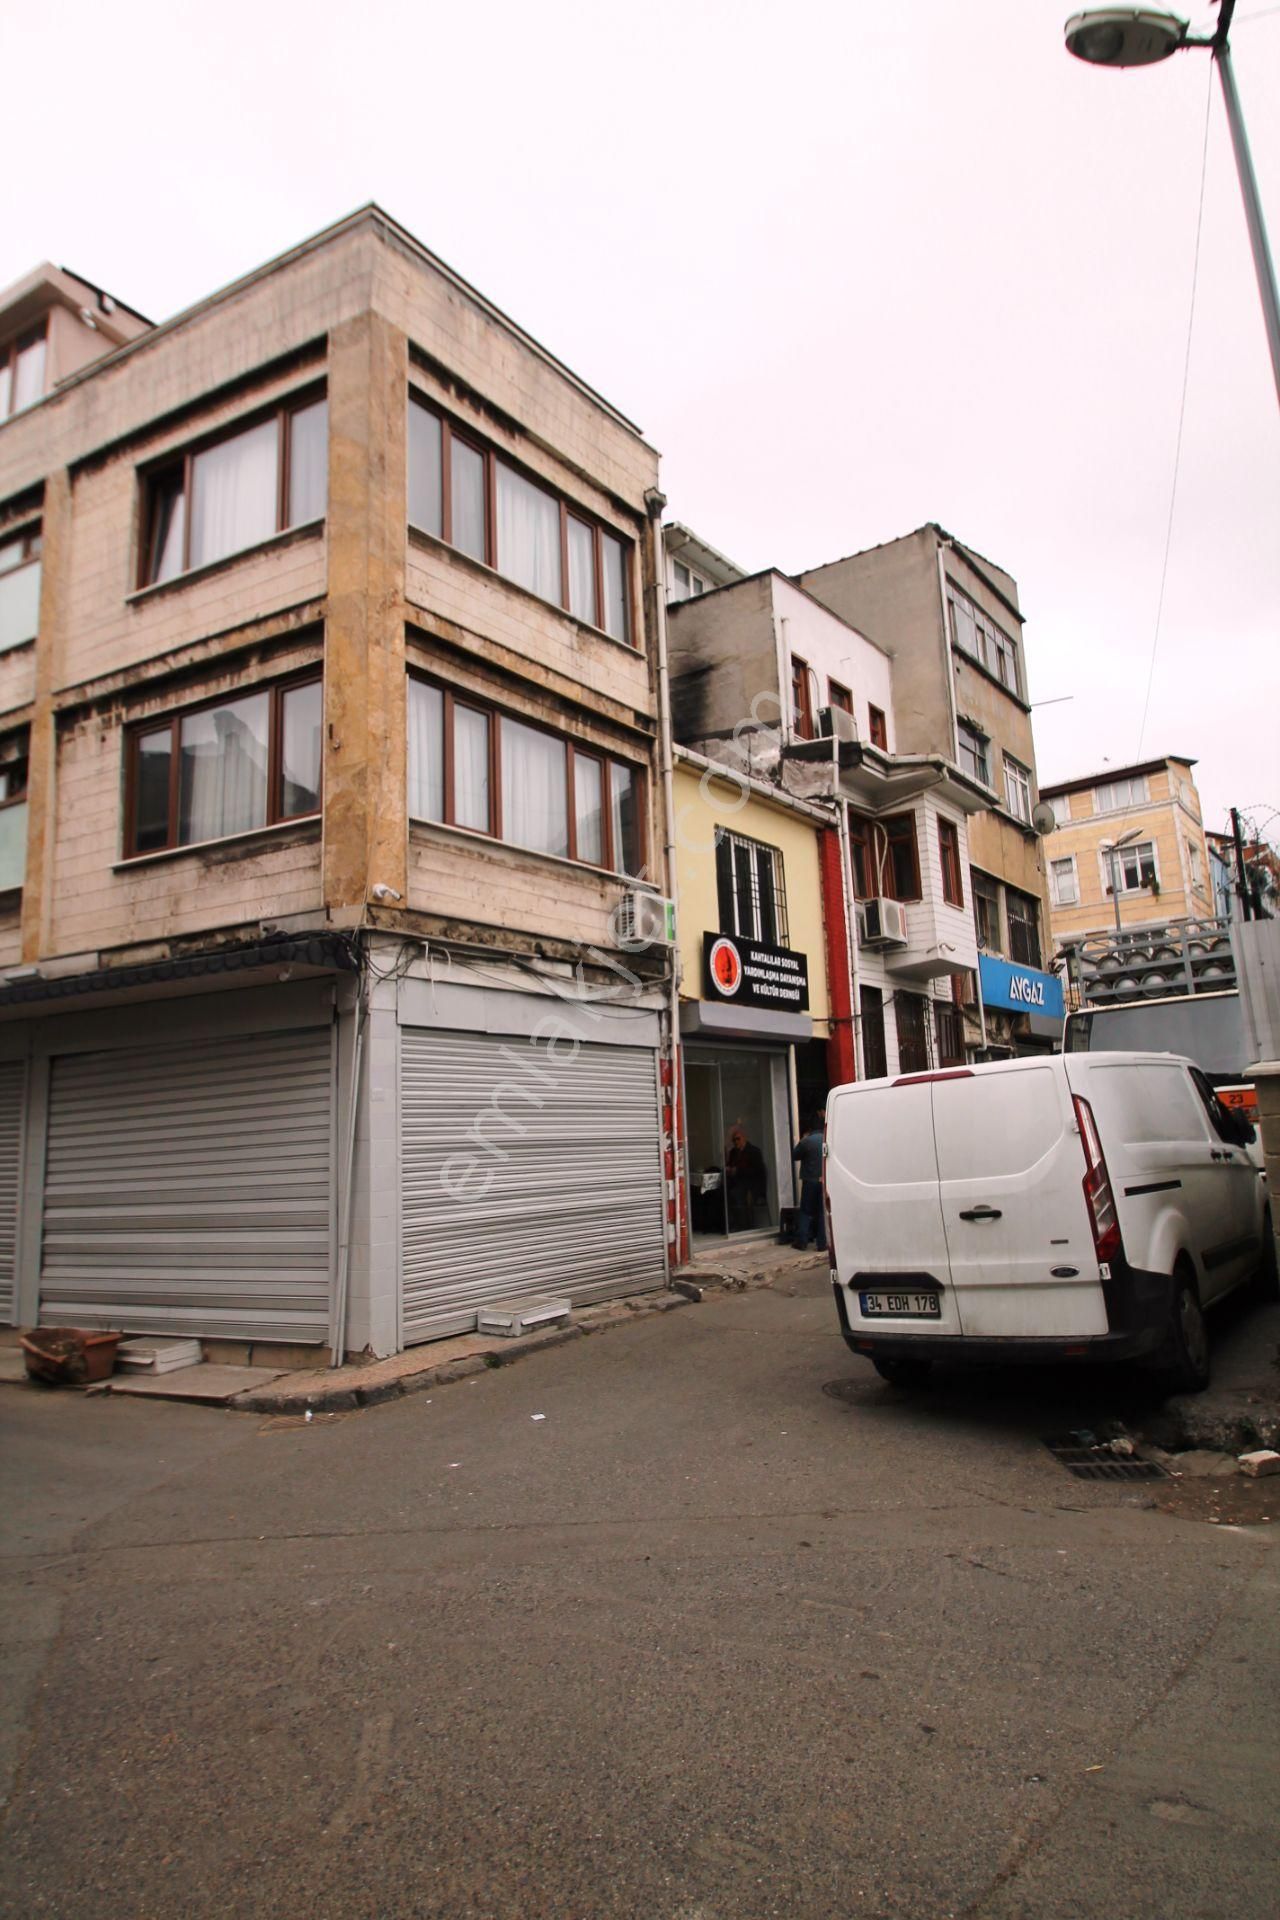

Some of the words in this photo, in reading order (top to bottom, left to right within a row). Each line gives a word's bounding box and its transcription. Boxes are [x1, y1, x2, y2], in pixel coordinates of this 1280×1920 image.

[781, 957, 799, 970] SOSYAL
[1009, 975, 1045, 1006] AYGAZ
[867, 1296, 882, 1311] 34
[914, 1296, 937, 1311] 178
